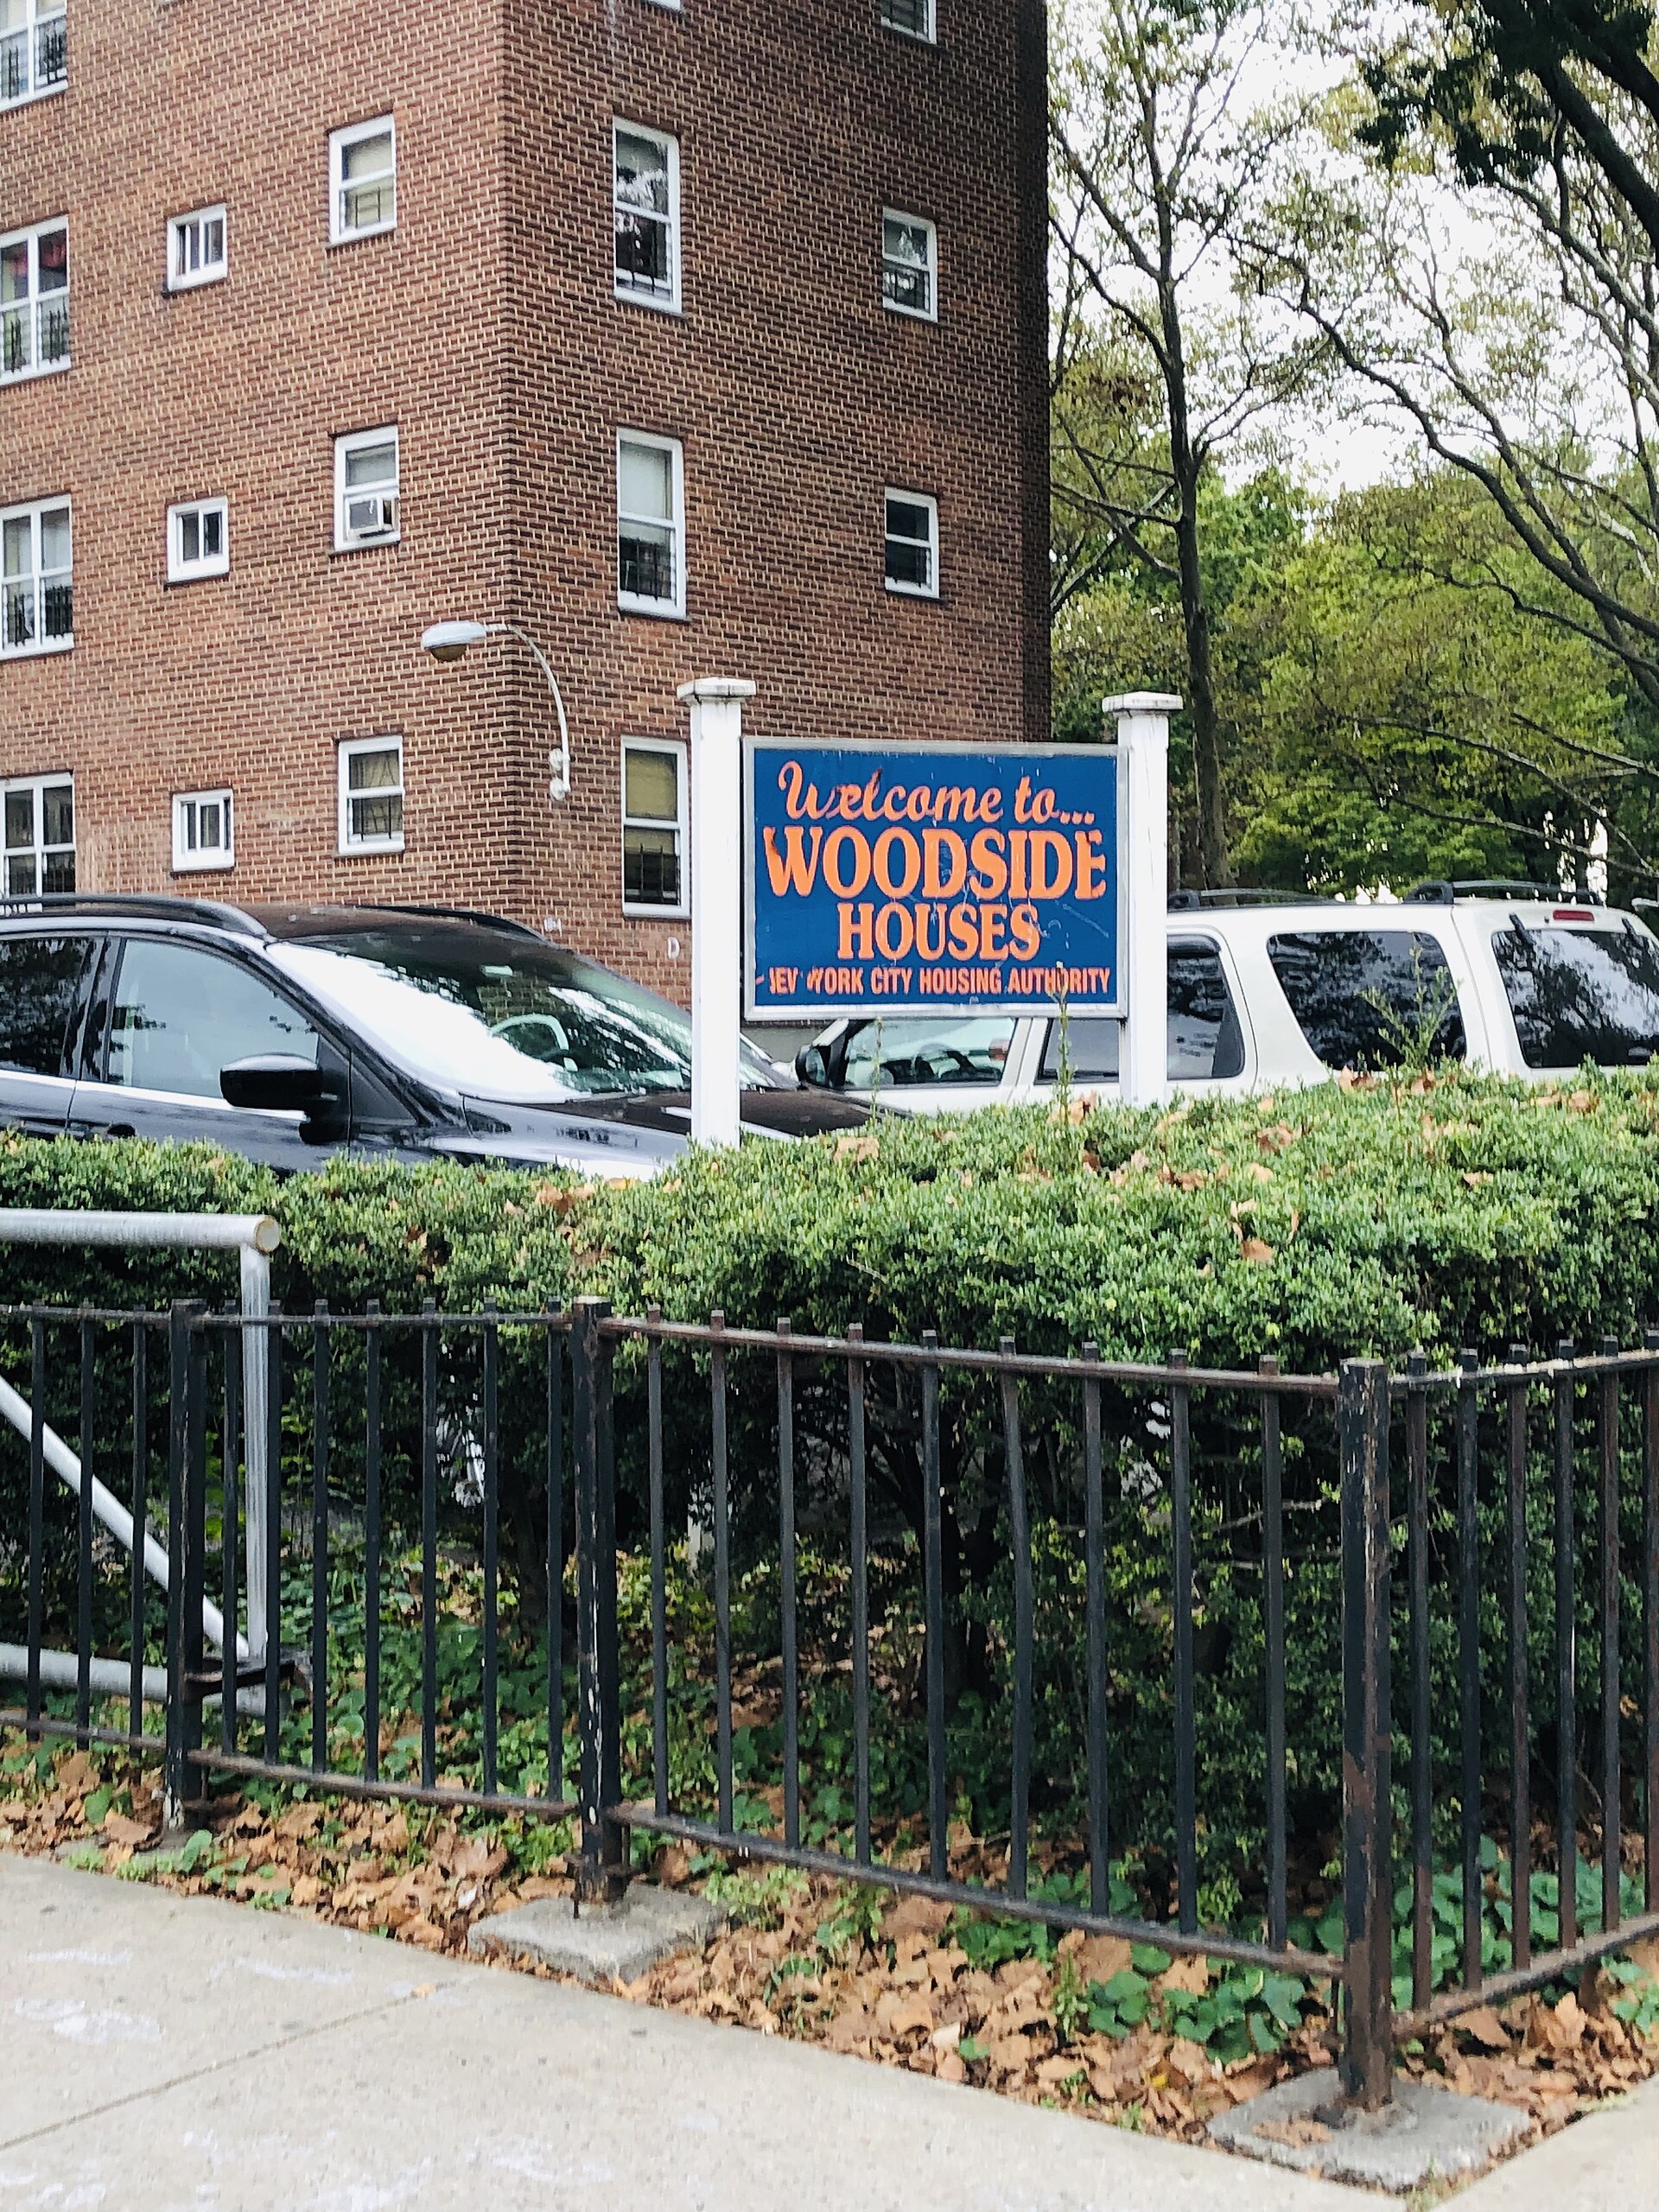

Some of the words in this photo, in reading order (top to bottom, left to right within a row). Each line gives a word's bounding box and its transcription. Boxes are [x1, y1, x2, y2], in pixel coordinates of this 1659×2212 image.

[778, 760, 1002, 823] Welcome
[763, 825, 1107, 900] WOODSIDE
[836, 902, 1041, 961] HOUSES
[807, 966, 864, 995] YORK
[870, 966, 912, 995] CITY
[918, 966, 1002, 995] HOUSING
[1007, 966, 1110, 995] AUTHORITY
